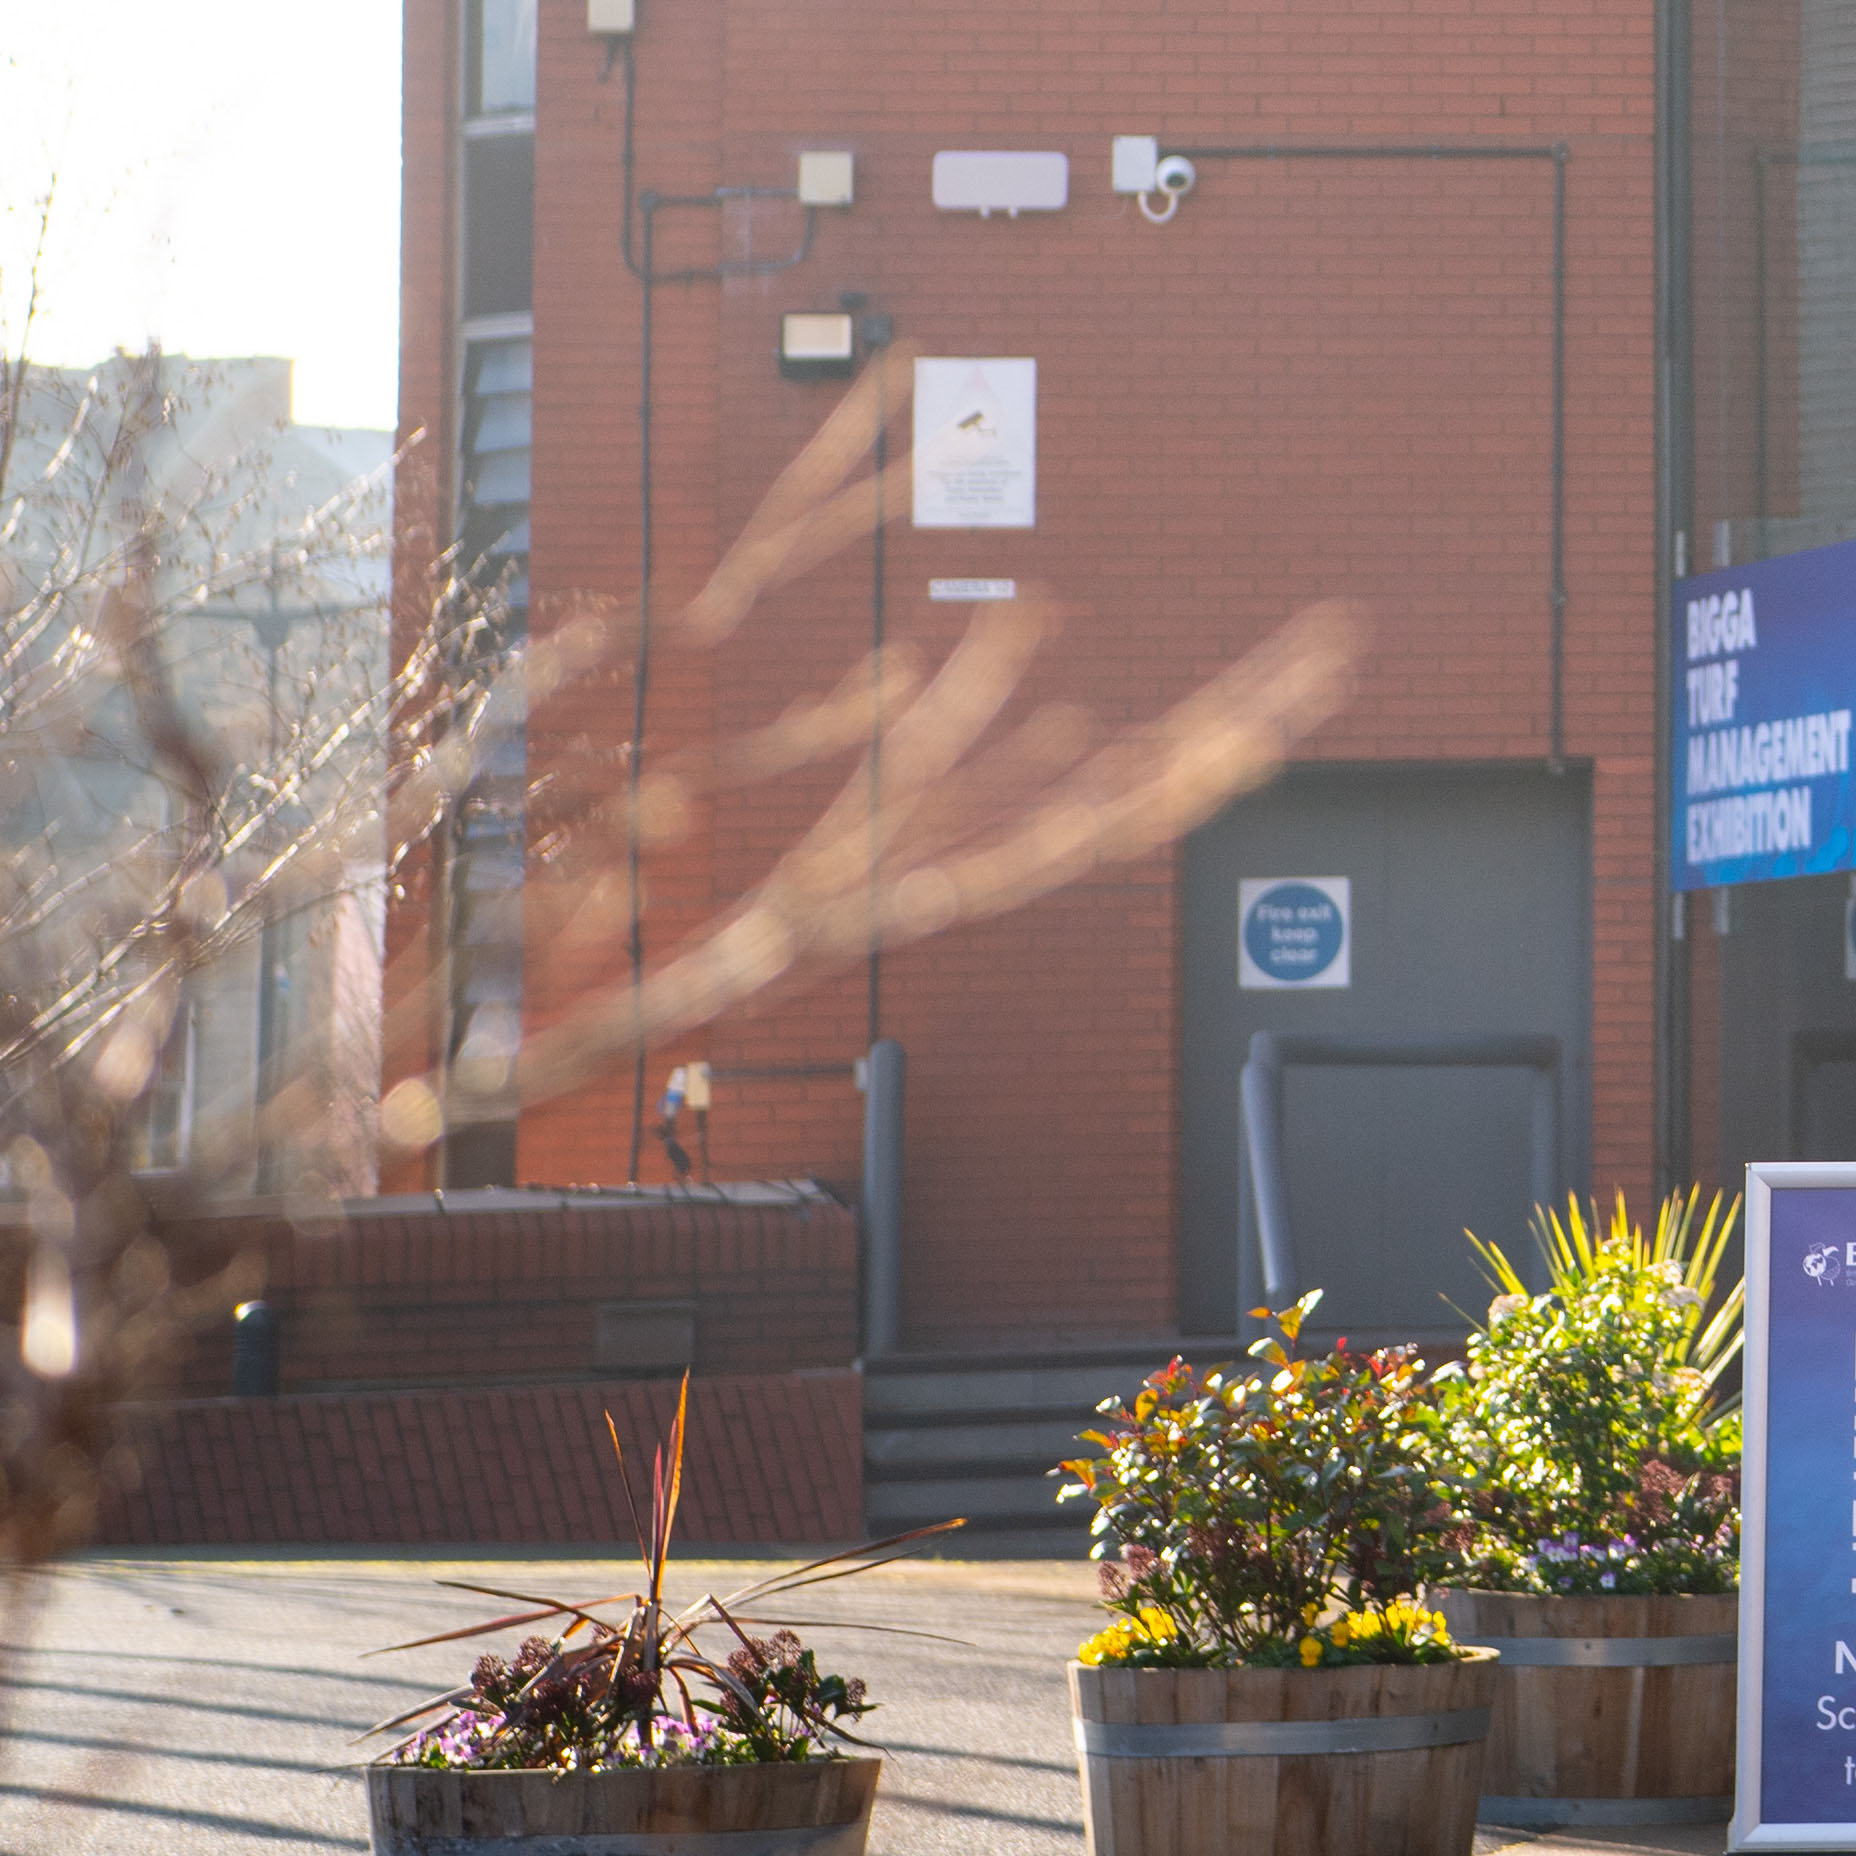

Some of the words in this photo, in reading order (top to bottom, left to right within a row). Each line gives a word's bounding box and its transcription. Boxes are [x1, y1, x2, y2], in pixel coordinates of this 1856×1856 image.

[1686, 588, 1757, 661] BIGGA
[1686, 659, 1739, 729] TURF
[1687, 708, 1852, 795] MANAGEMENT
[1686, 785, 1812, 865] EXHIBITION
